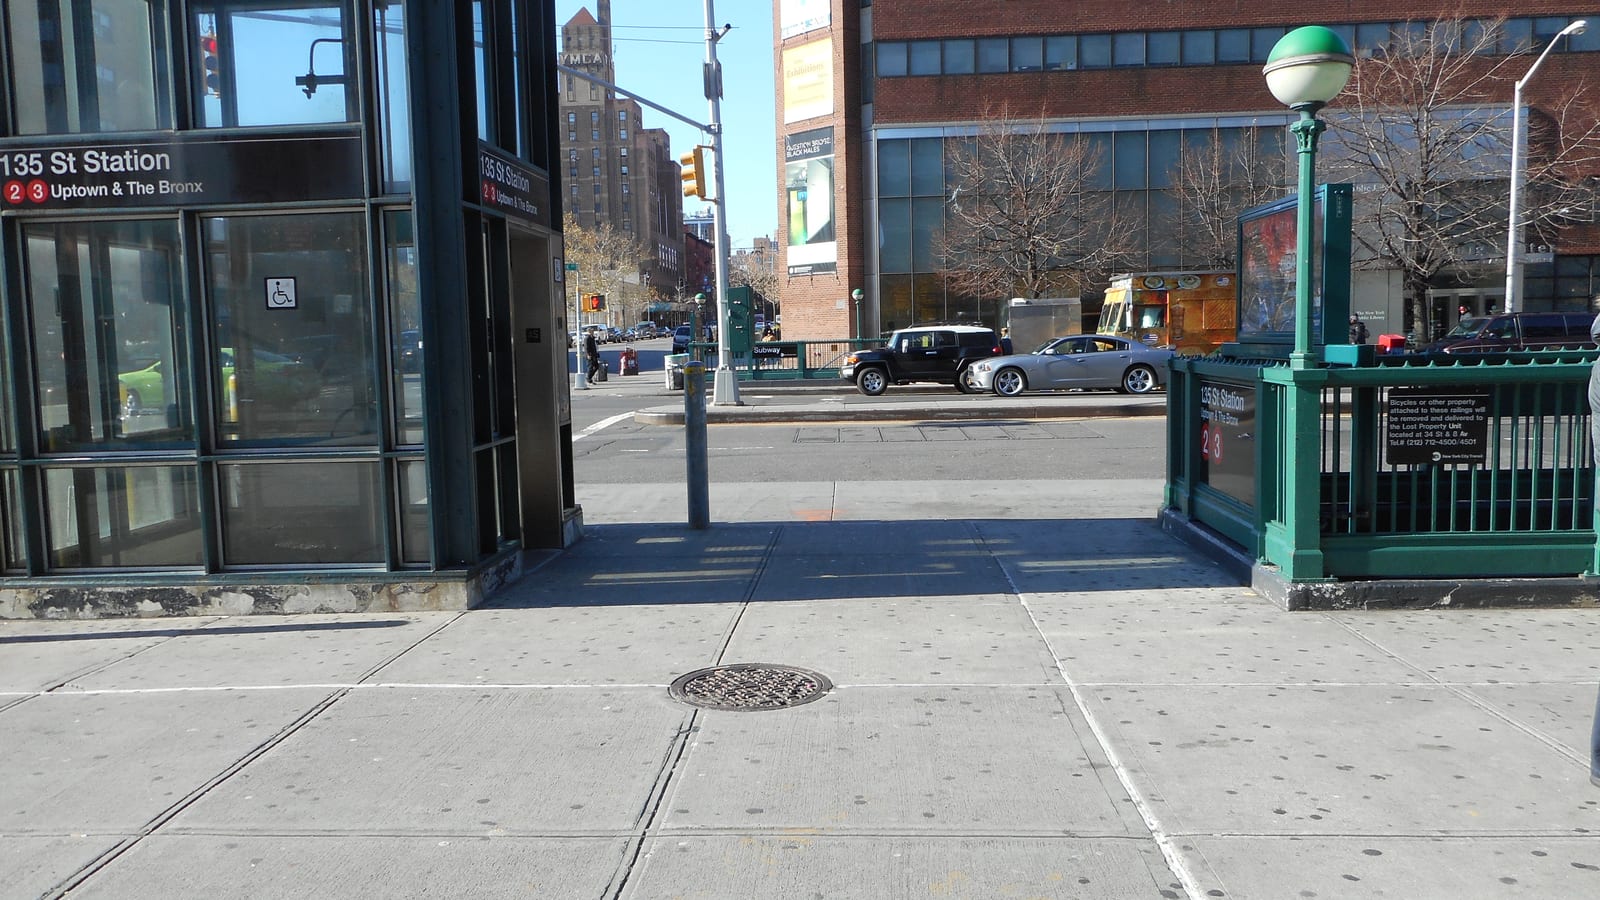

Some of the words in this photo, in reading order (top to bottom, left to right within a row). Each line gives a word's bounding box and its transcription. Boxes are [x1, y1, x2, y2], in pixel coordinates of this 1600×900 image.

[560, 53, 602, 64] YMCA
[0, 153, 43, 176] 135
[50, 151, 77, 174] St
[83, 149, 170, 173] Station
[786, 149, 802, 158] BLACK
[803, 146, 820, 154] MALES
[480, 155, 495, 178] 135
[496, 161, 505, 183] St
[506, 166, 529, 192] Station
[9, 185, 20, 200] 2
[33, 184, 44, 199] 3
[51, 184, 108, 201] Uptown
[112, 182, 123, 196] &
[126, 181, 155, 195] The
[158, 179, 203, 194] Bronx
[483, 183, 489, 198] 2
[490, 187, 496, 201] 3
[496, 189, 513, 206] Uptown
[753, 346, 780, 354] Subway
[1201, 386, 1211, 404] 135
[1211, 387, 1220, 406] St
[1220, 389, 1244, 411] Station
[1203, 430, 1209, 454] 2
[1214, 434, 1220, 458] 3
